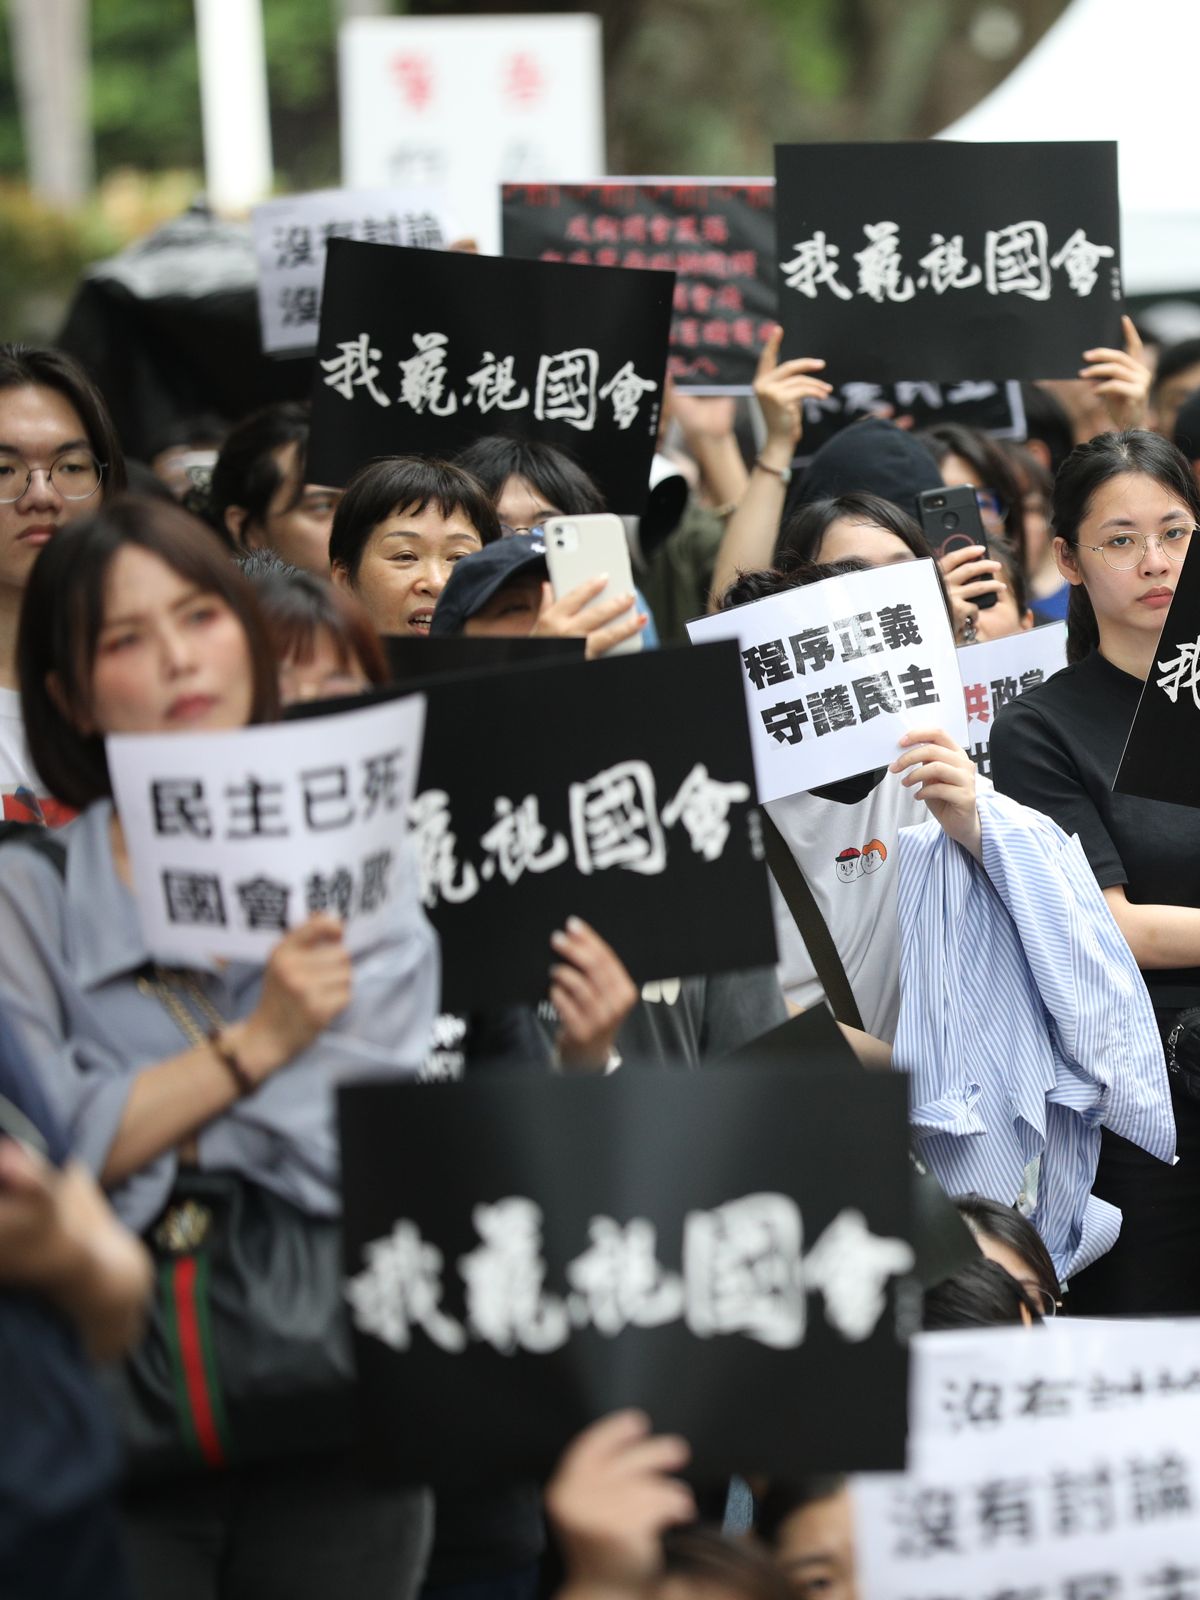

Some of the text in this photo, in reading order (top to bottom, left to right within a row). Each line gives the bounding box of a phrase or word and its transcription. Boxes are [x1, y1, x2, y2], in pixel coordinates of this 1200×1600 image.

[741, 603, 923, 690] 程序正義
[761, 663, 940, 745] 守護民主
[148, 746, 404, 842] 民主已死
